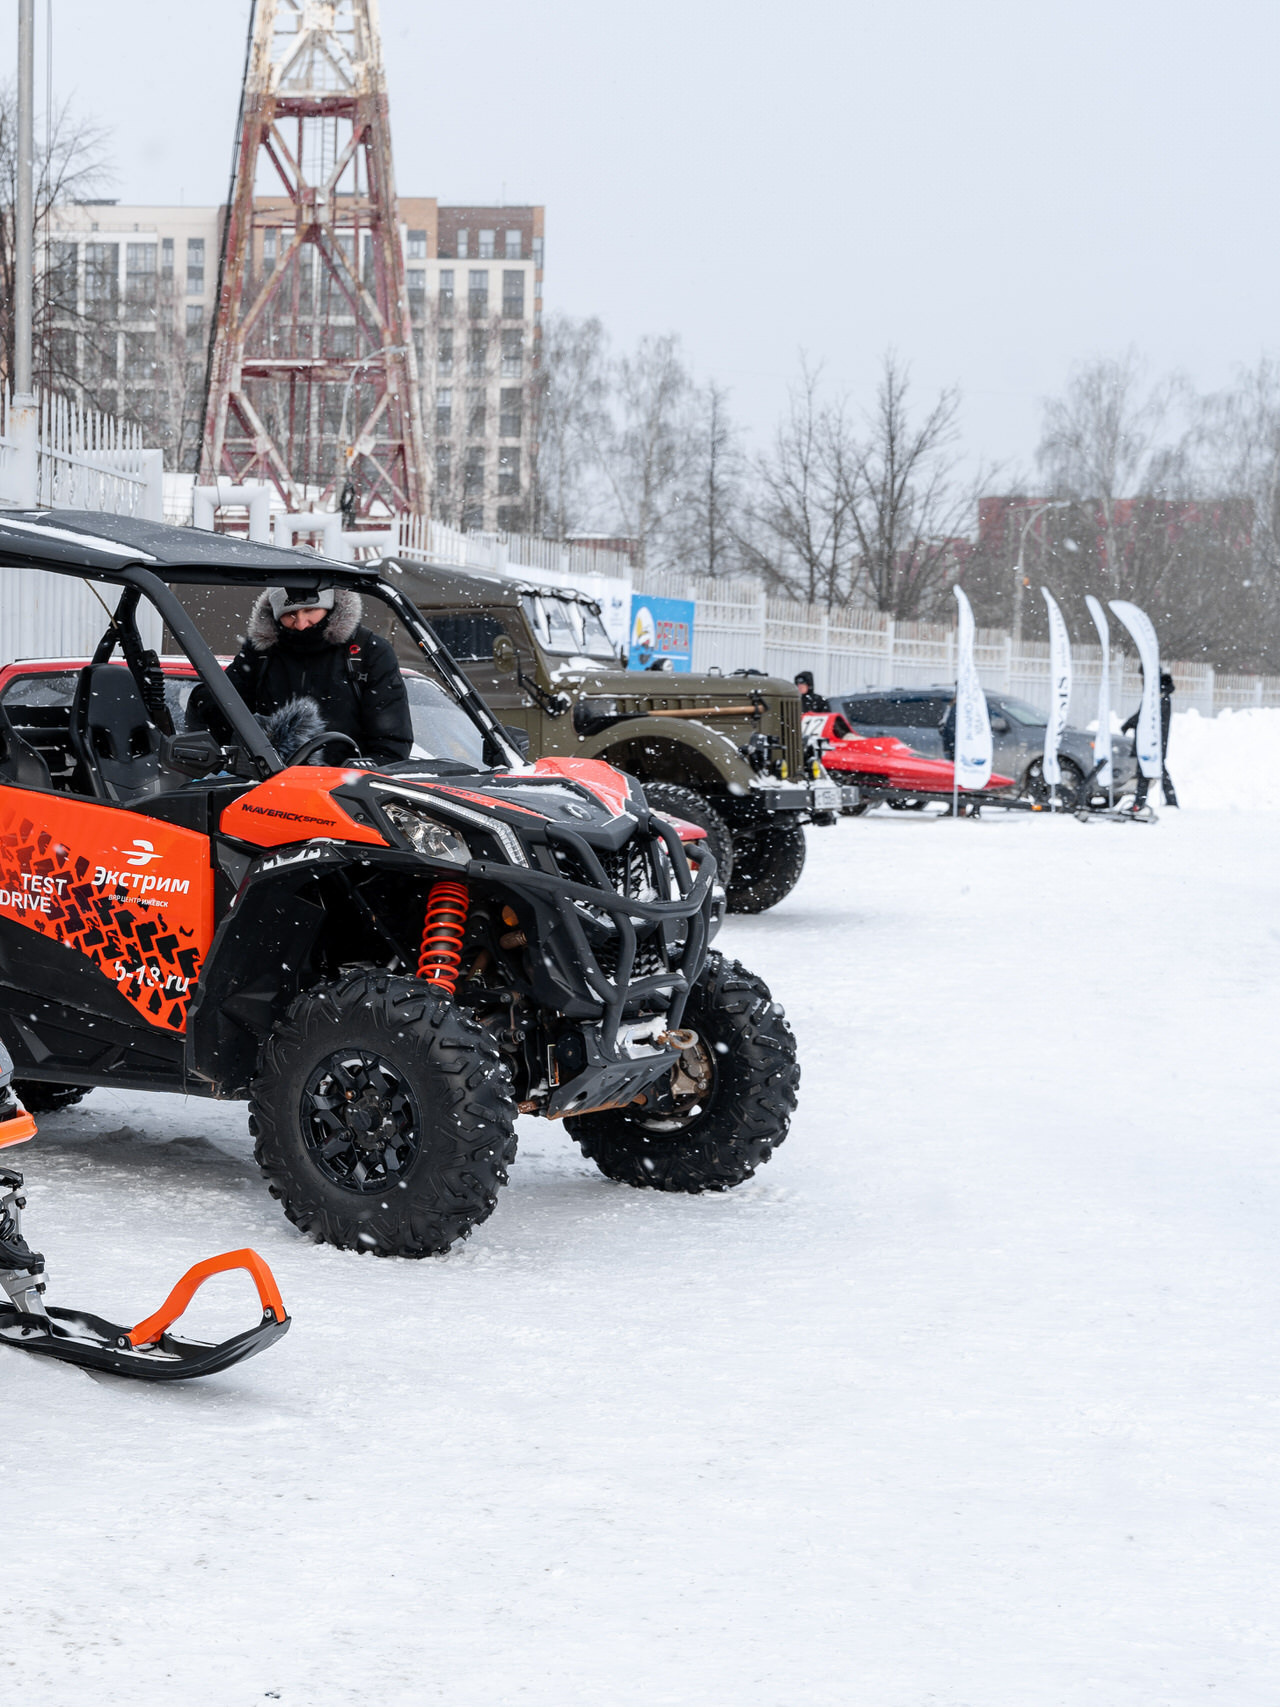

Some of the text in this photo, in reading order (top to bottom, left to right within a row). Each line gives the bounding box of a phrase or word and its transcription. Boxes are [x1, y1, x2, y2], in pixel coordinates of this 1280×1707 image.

[21, 873, 68, 896] TEST
[91, 866, 190, 895] Экстрим
[121, 895, 141, 904] ЦЕНТР
[141, 898, 169, 907] ИЖЕВСК
